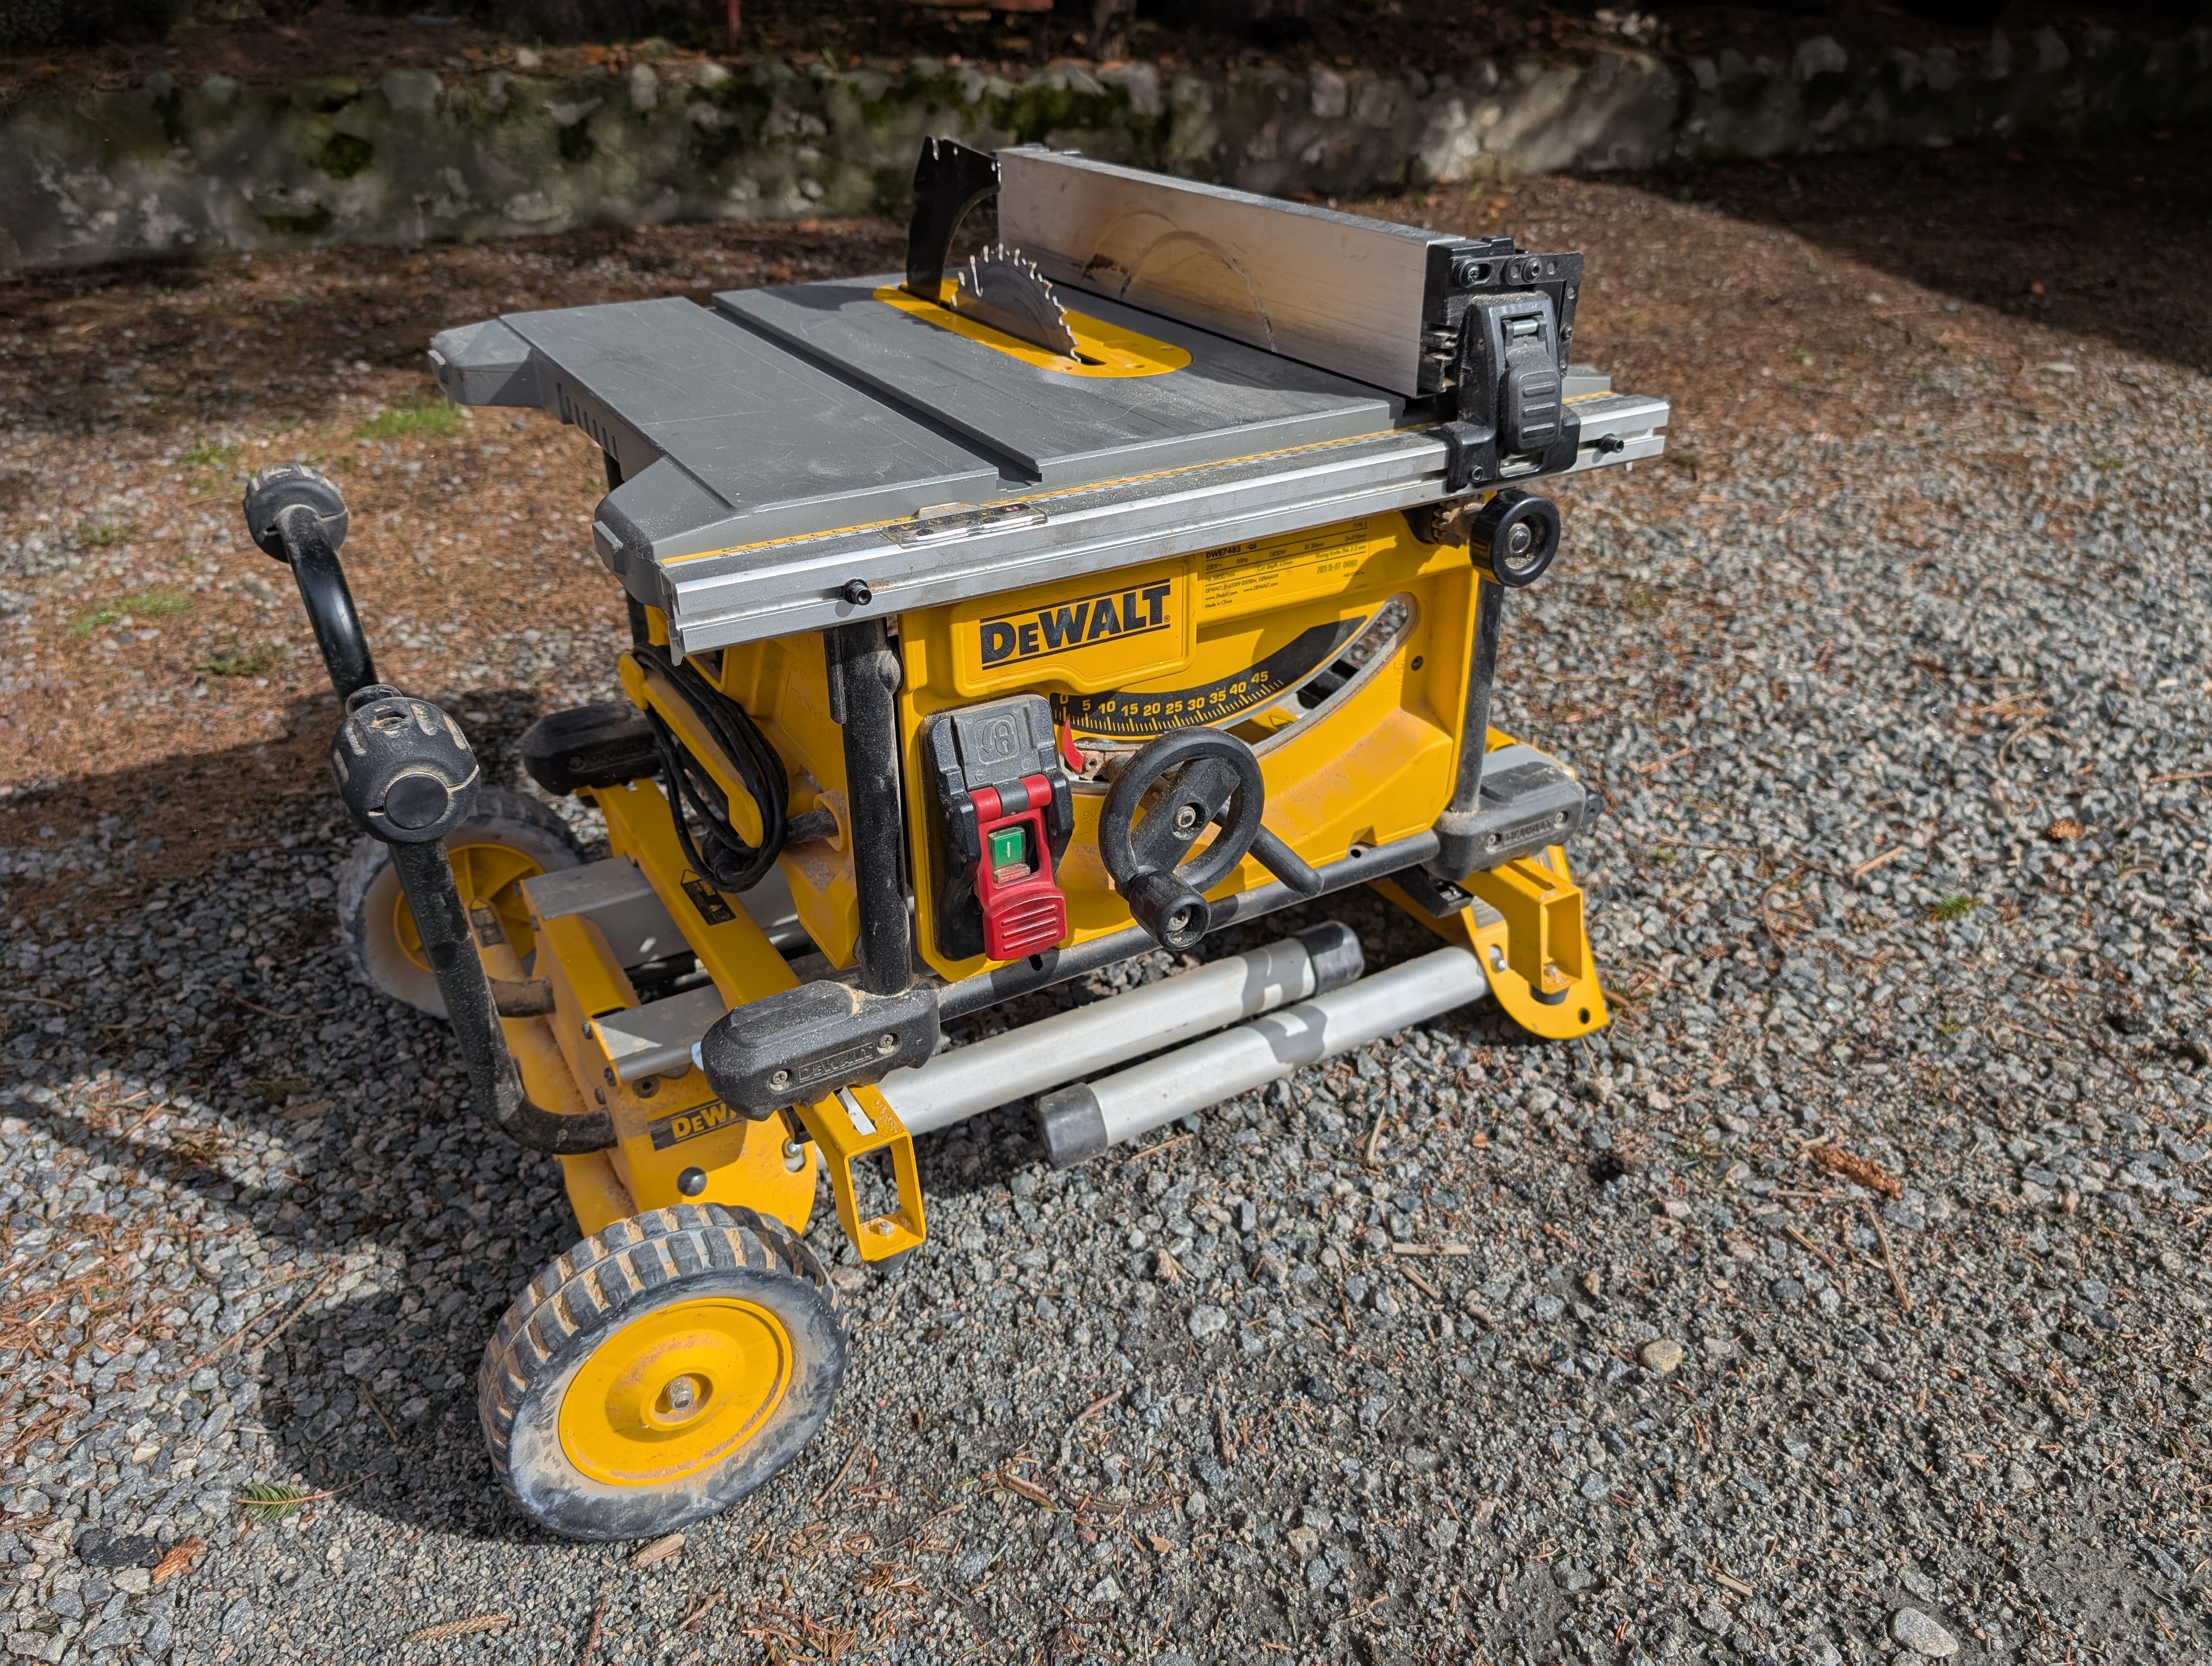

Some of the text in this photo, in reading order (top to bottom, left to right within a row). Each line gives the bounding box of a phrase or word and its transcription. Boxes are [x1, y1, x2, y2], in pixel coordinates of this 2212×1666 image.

[1206, 545, 1242, 559] DWE7485
[1269, 549, 1286, 558] 1850W
[1266, 561, 1278, 571] depth
[1224, 581, 1241, 589] D-65509
[1258, 574, 1279, 582] GERMANY
[1243, 582, 1278, 593] www.DEWALT.com
[1059, 670, 1269, 717] 0 5 10 15 20 25 30 35 40 45
